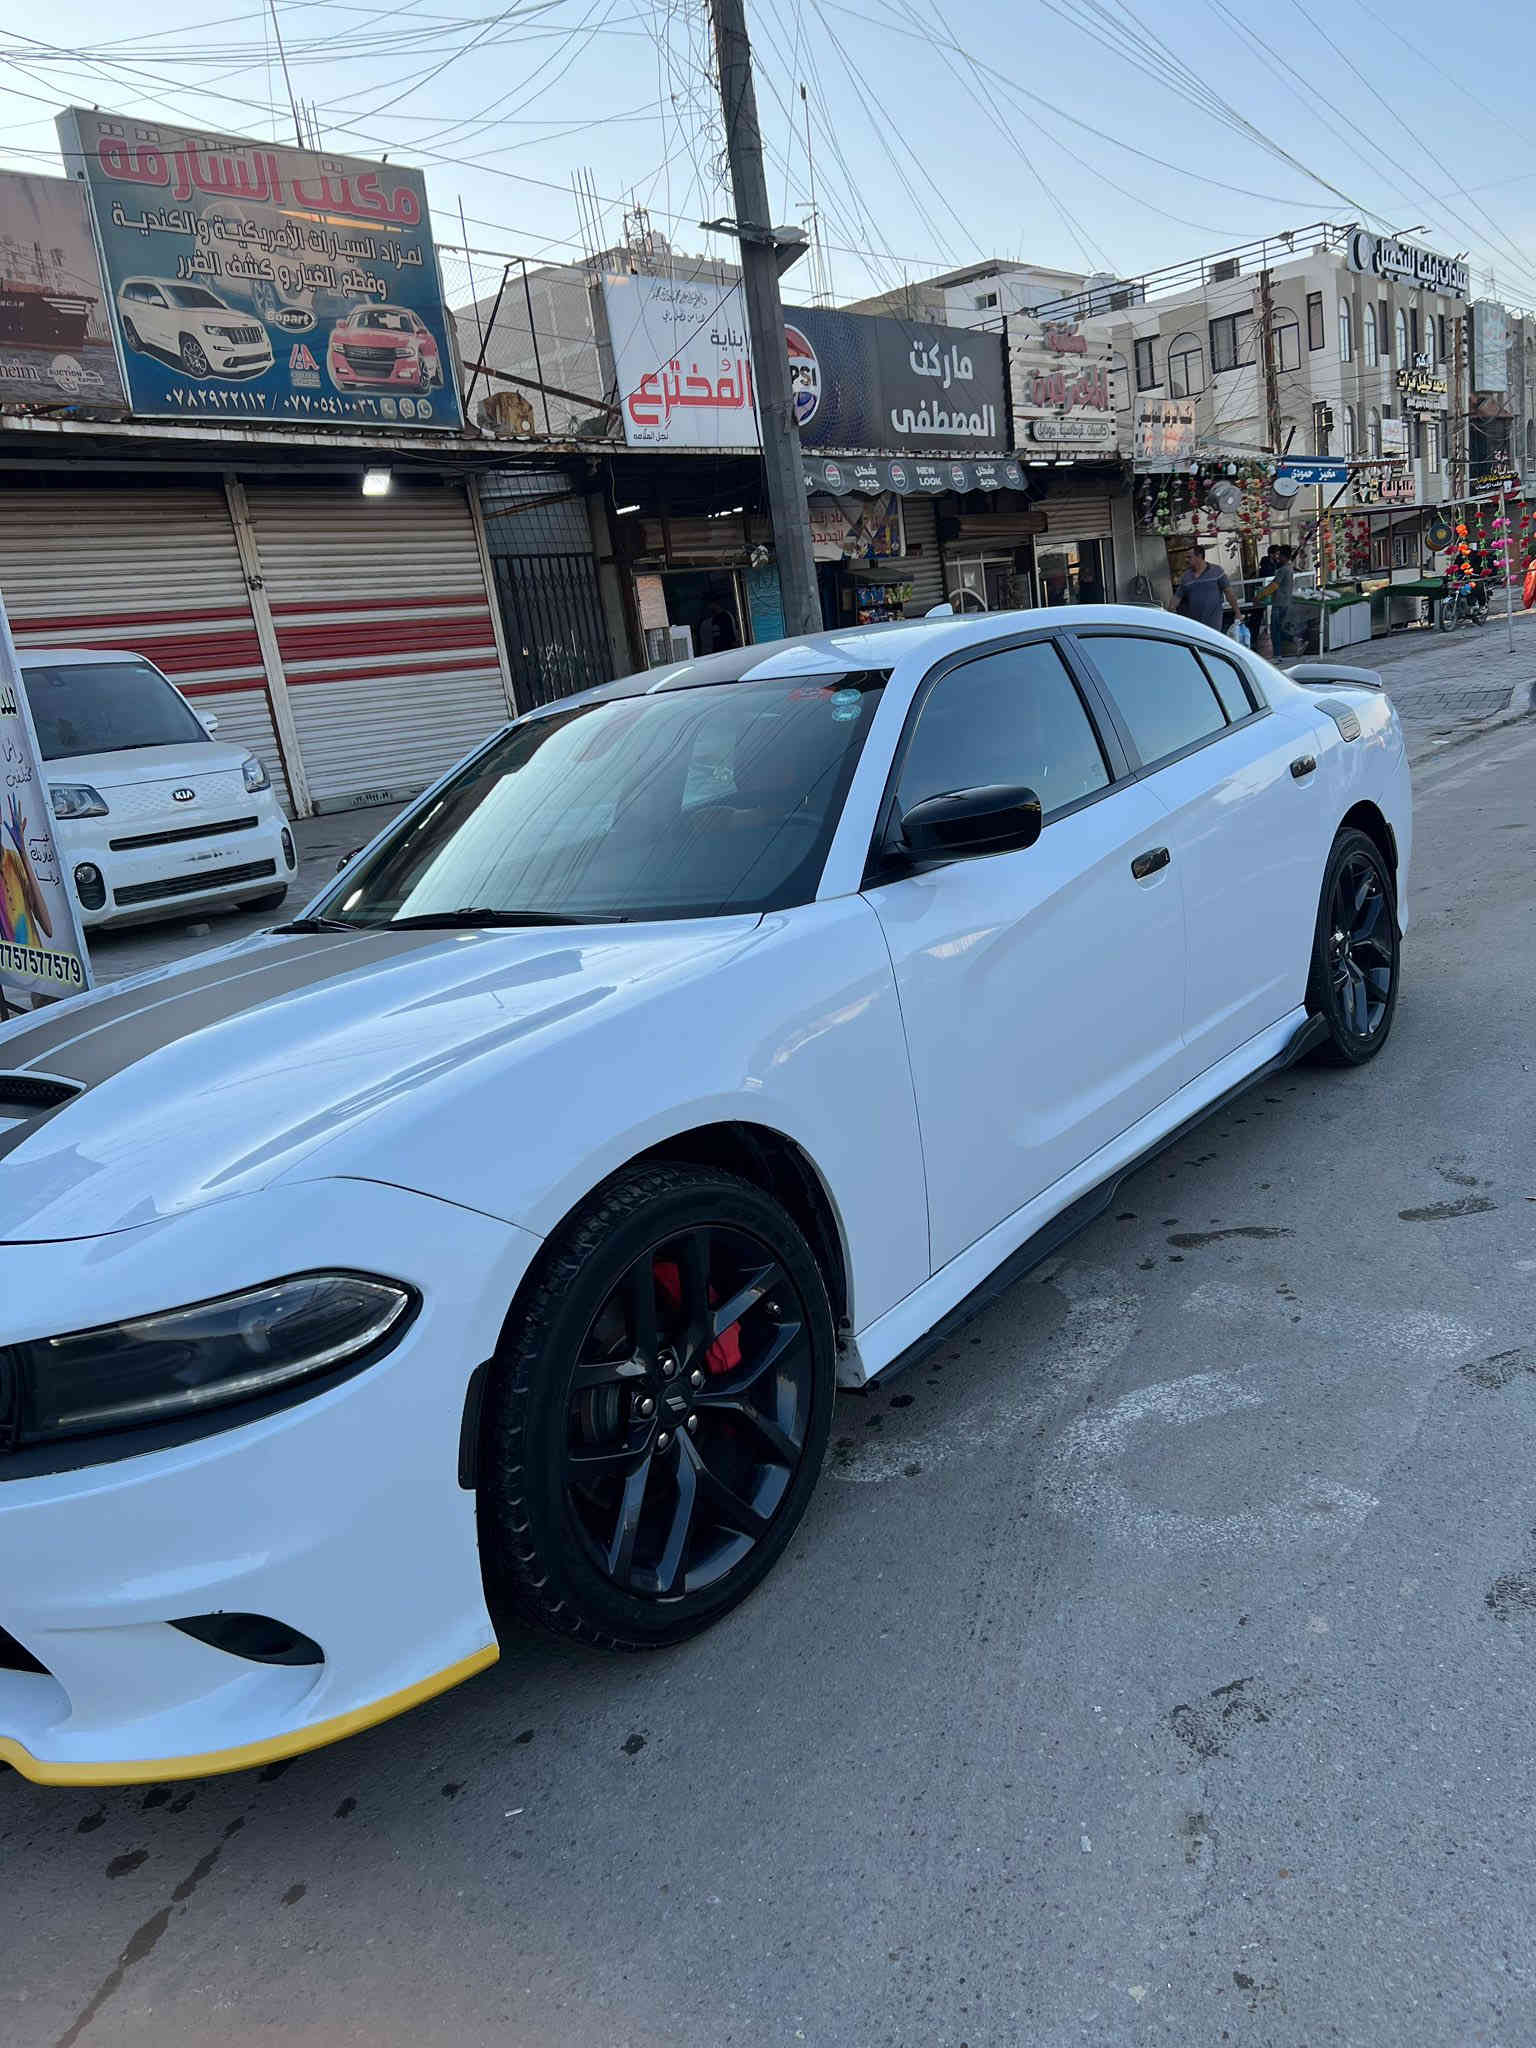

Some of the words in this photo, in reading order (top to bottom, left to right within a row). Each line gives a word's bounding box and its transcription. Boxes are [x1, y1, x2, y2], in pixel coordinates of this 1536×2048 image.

[97, 121, 285, 203] الشارقة
[292, 159, 421, 225] مكتب
[112, 203, 211, 244] والكندية
[308, 229, 376, 261] السيارات
[381, 240, 424, 270] لمزاد
[176, 252, 222, 280] الضرر
[225, 252, 275, 281] كشف
[296, 262, 336, 292] الغيار
[342, 269, 387, 300] وقطع
[710, 327, 743, 352] بناية
[790, 365, 817, 387] PSI
[909, 340, 974, 389] ماركت
[891, 399, 996, 437] المصطفى
[916, 466, 935, 474] NEW
[919, 477, 942, 487] LOOK
[175, 790, 194, 800] KIA
